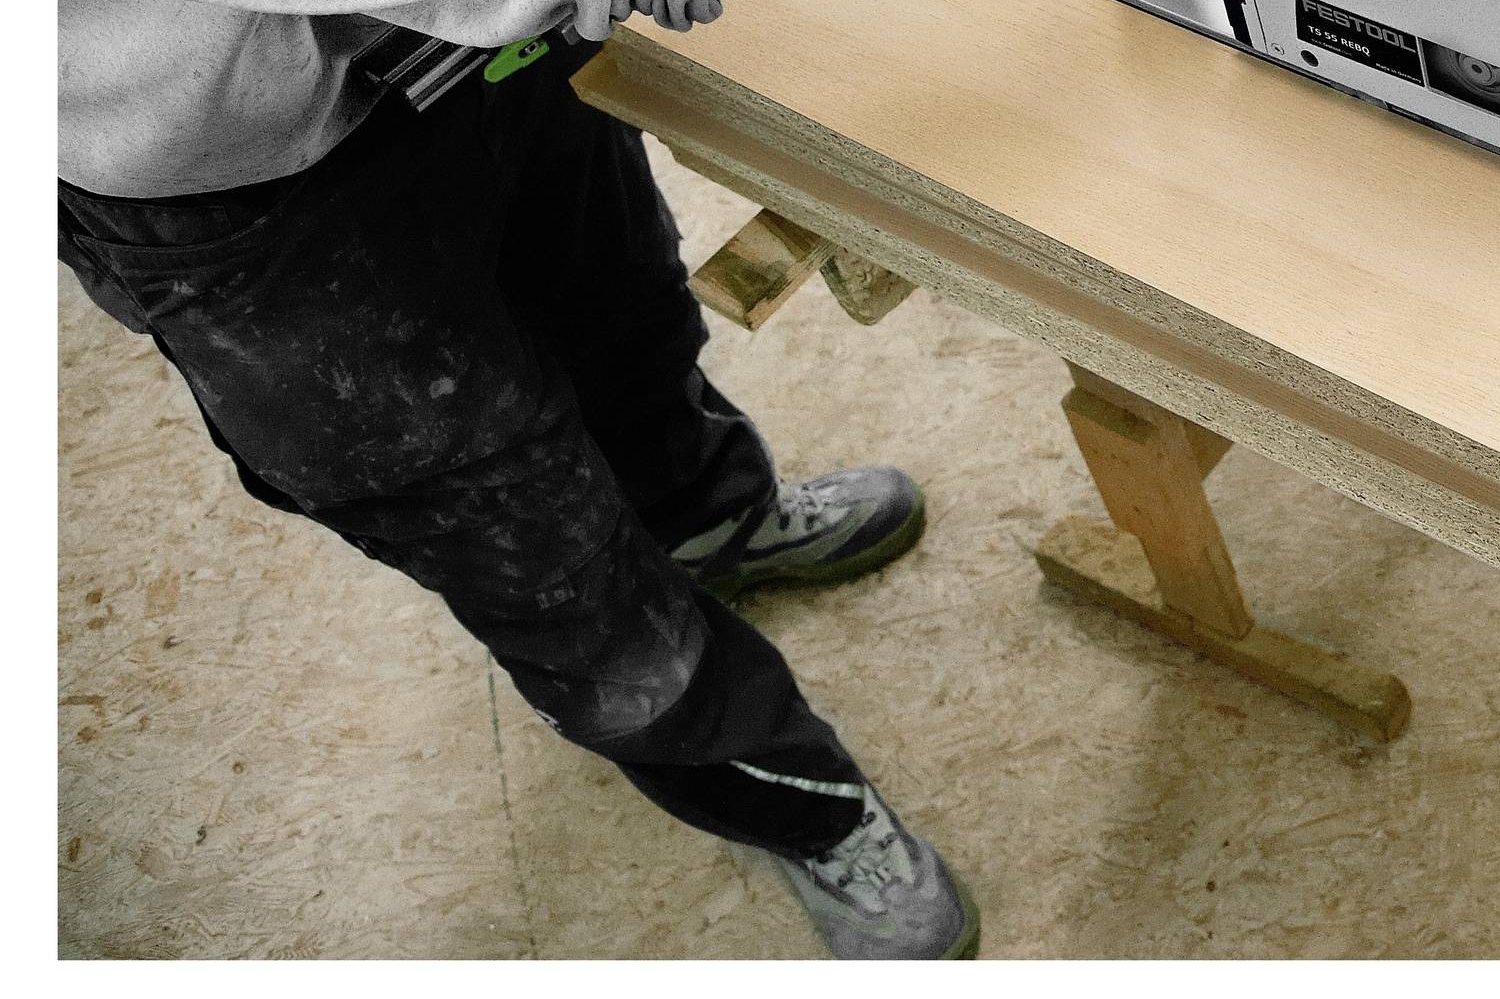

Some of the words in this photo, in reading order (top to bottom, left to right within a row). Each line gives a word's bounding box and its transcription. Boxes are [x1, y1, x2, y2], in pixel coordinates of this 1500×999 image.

[1308, 25, 1322, 36] TS
[1324, 32, 1338, 42] 55
[1341, 38, 1371, 57] REBQ
